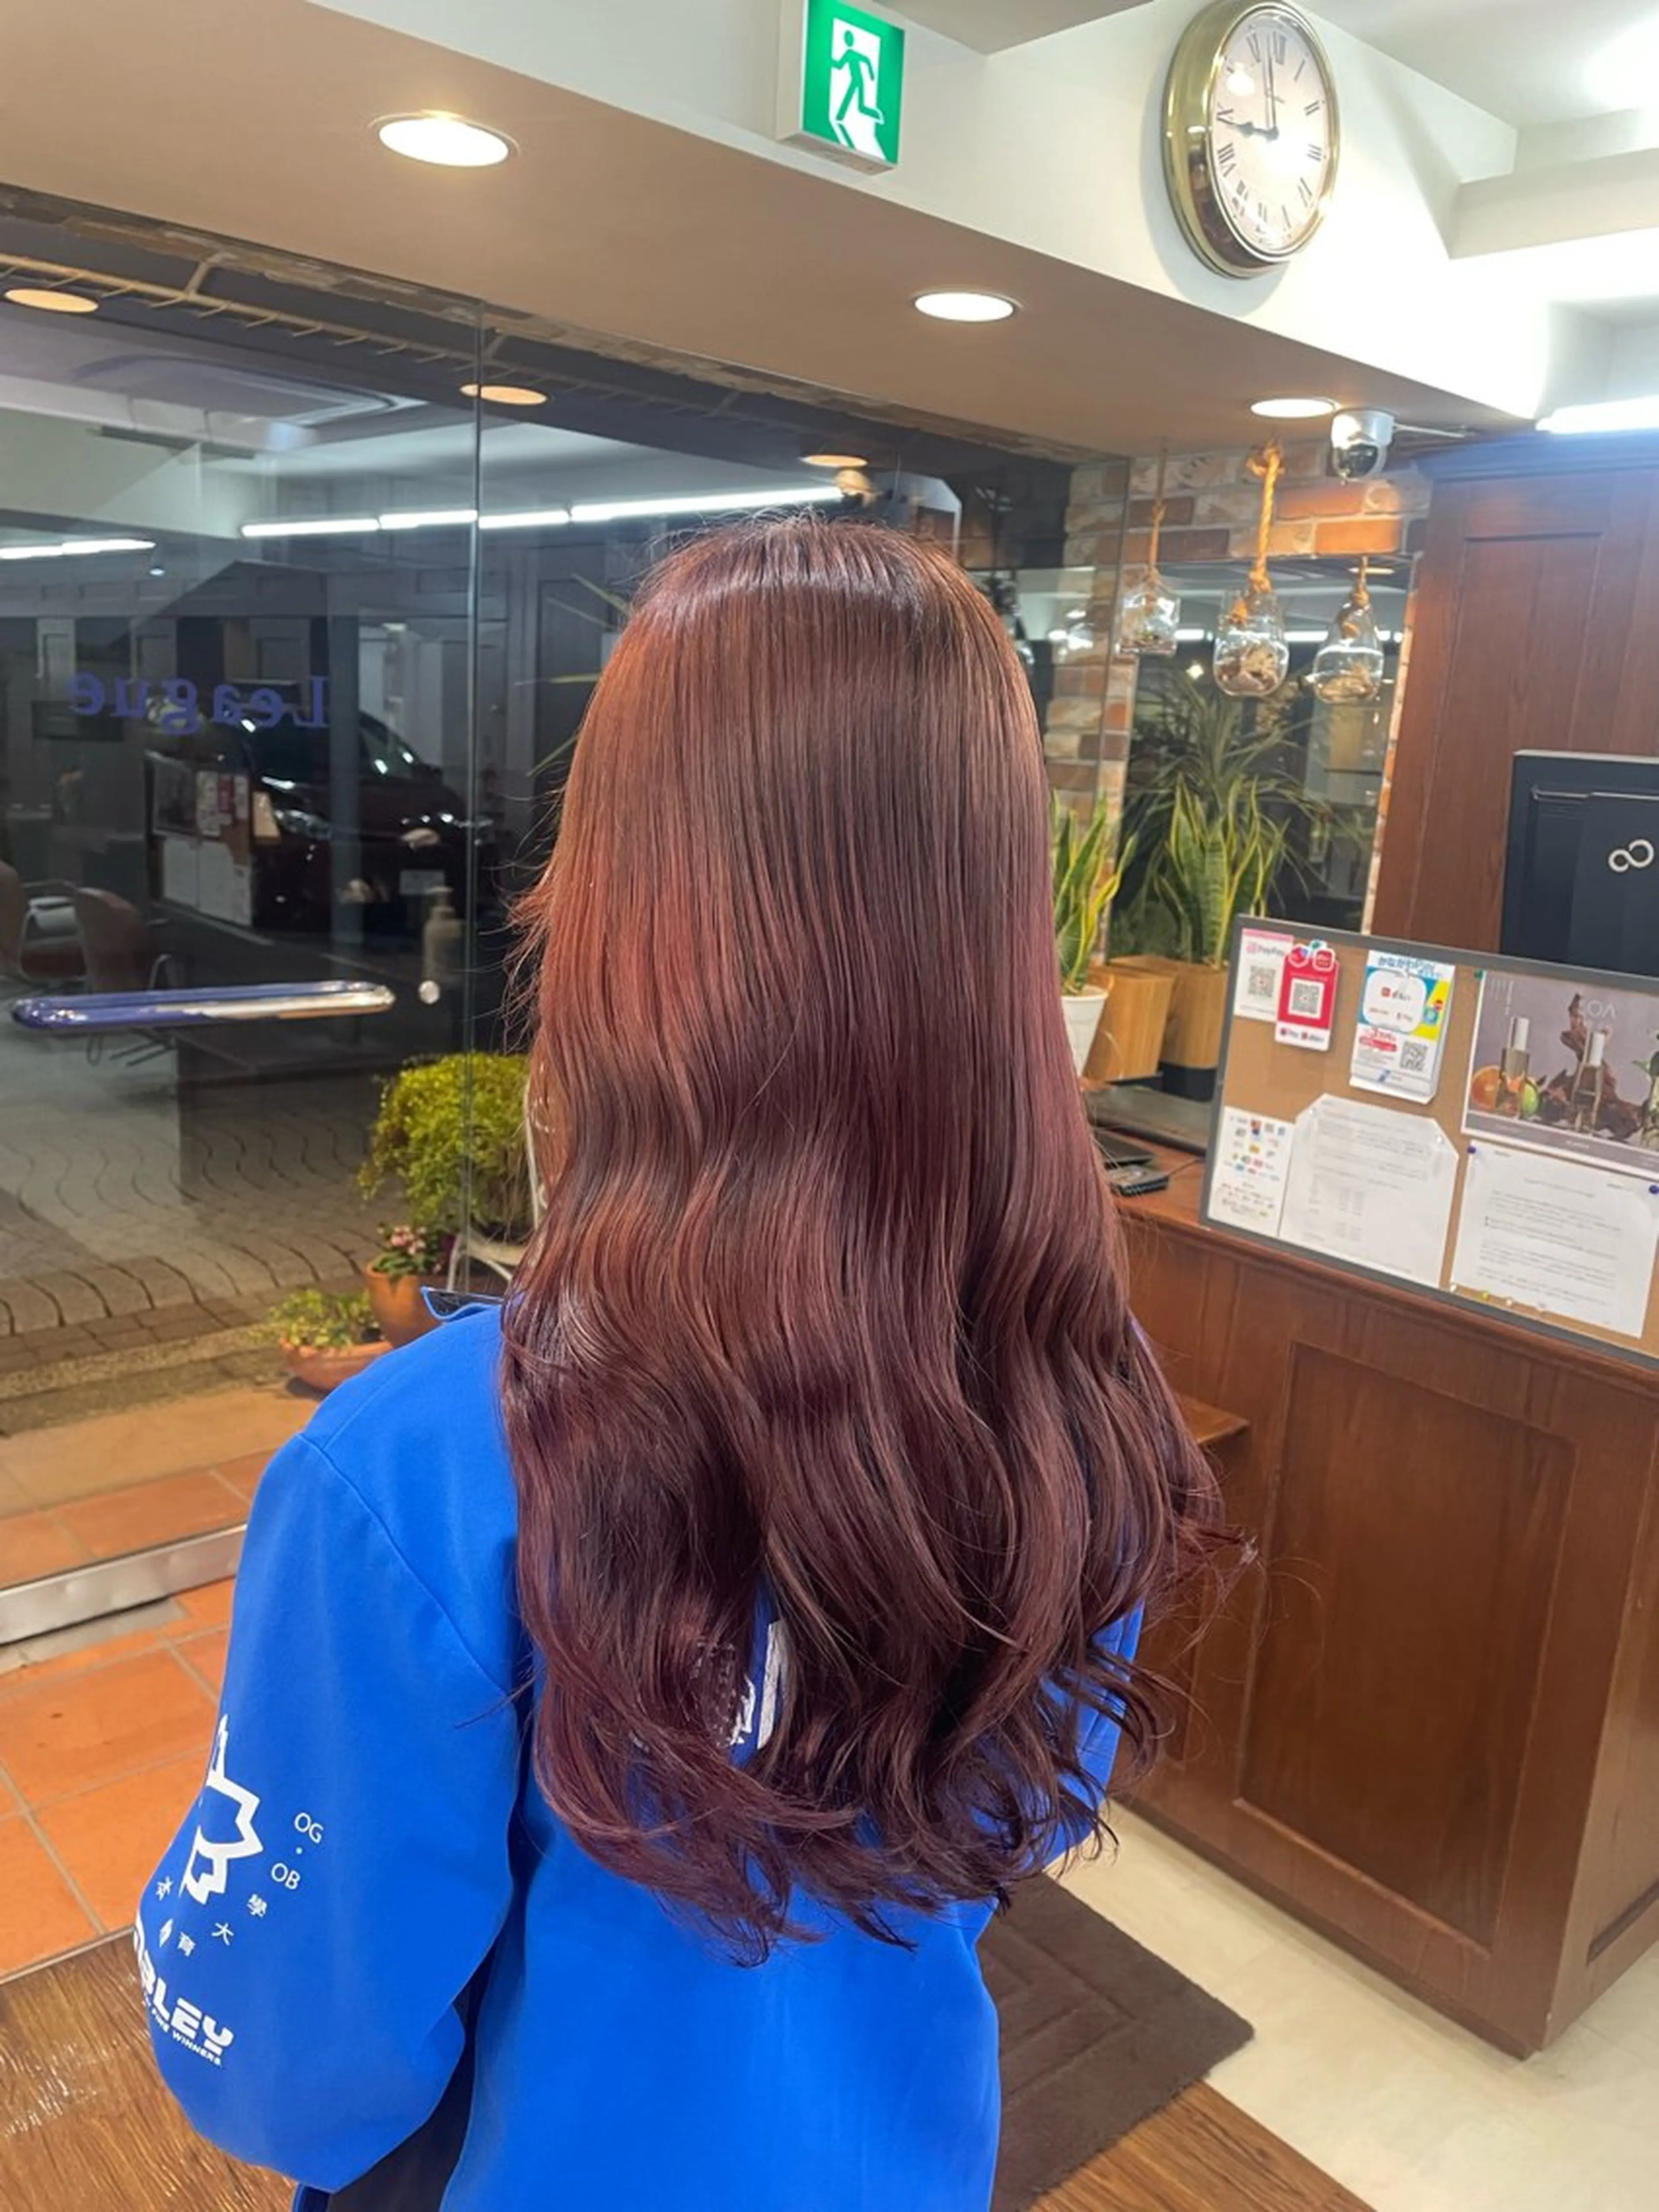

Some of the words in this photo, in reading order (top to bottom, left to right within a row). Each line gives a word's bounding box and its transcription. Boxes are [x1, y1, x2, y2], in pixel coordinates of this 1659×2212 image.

[294, 1812, 324, 1844] OG
[271, 1862, 301, 1890] OB
[172, 2030, 222, 2066] WINNERS
